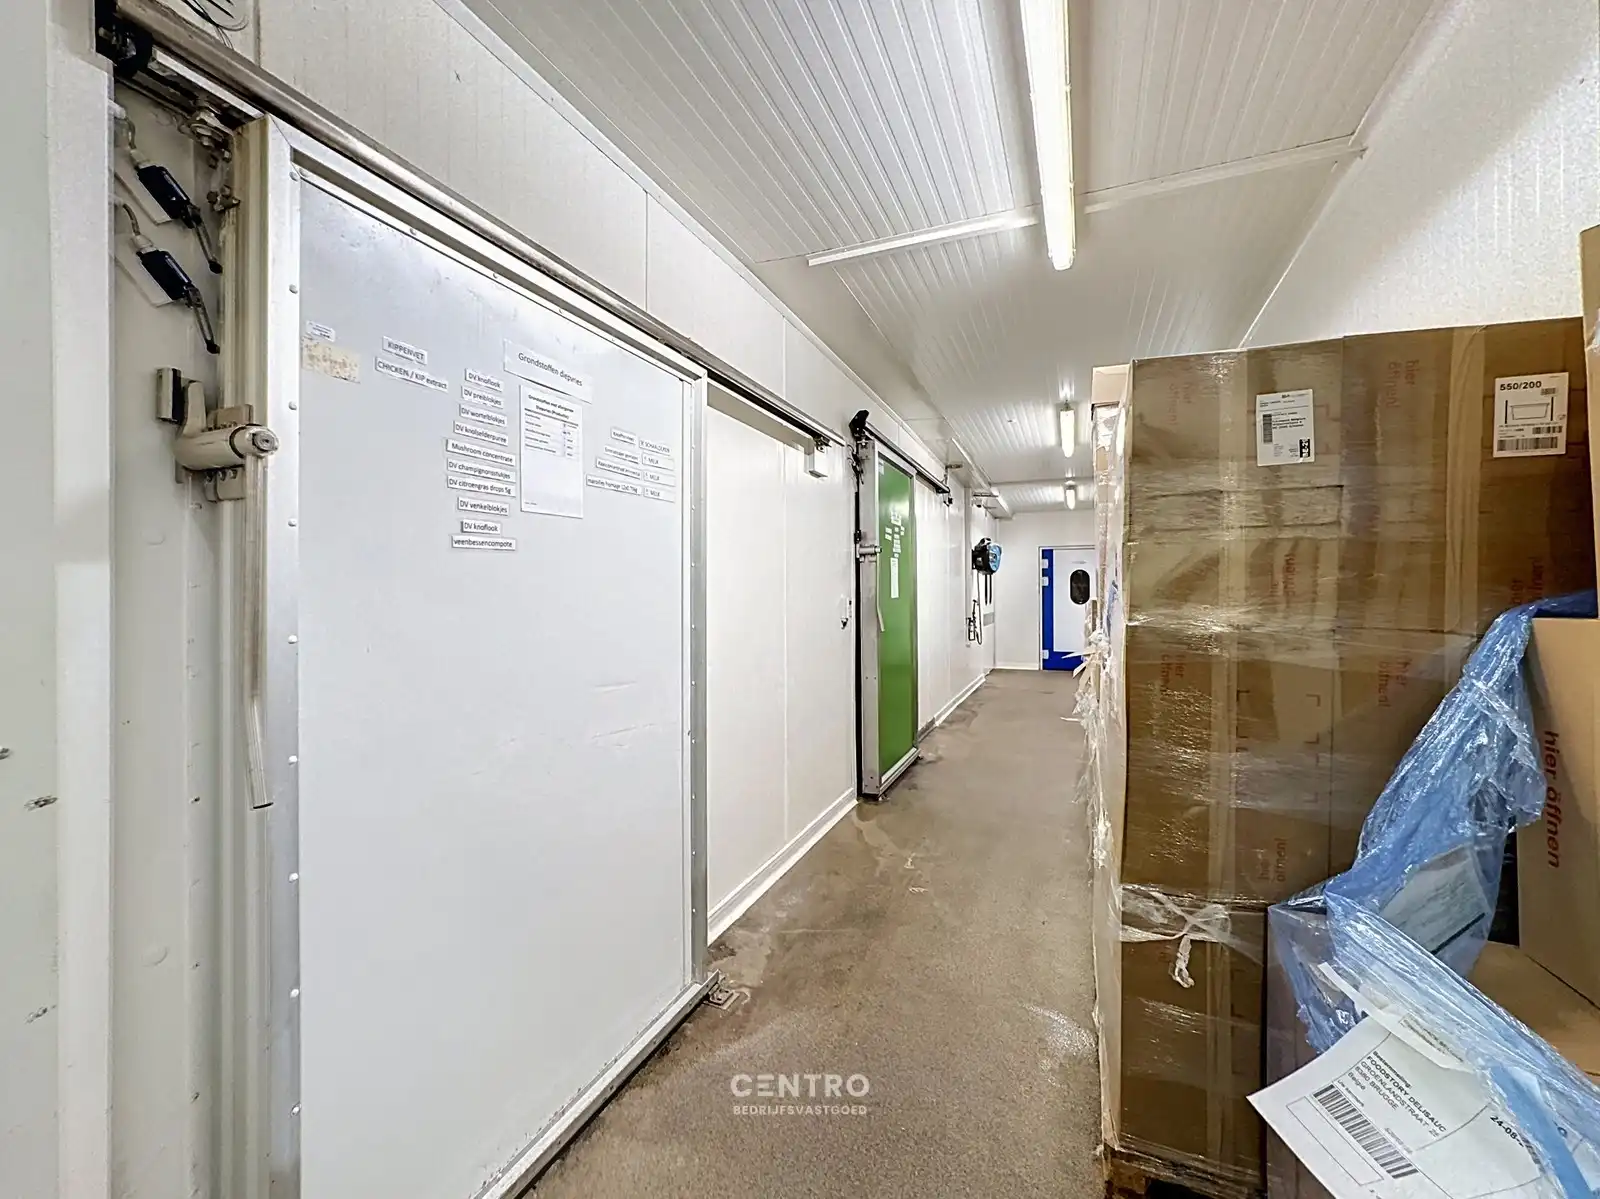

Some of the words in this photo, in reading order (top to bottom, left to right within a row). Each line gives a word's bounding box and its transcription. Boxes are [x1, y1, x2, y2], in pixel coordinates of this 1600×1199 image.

[518, 352, 559, 375] Grondstoffen
[377, 361, 409, 377] CHICKEN
[426, 378, 447, 389] extract
[468, 372, 476, 380] DV
[1499, 381, 1542, 391] 550/200
[464, 389, 472, 397] DV
[461, 407, 469, 415] DV
[456, 424, 464, 432] DV
[451, 443, 481, 455] Mushroom
[482, 451, 513, 463] concentrate
[458, 480, 489, 490] citroengras
[490, 484, 504, 492] drops
[470, 503, 507, 513] venkelblokjes
[464, 522, 473, 530] DV
[473, 523, 498, 532] knoflook
[454, 538, 513, 548] veenbessencompote
[1544, 730, 1560, 780] hier
[1547, 786, 1562, 869] öffnen
[1360, 1061, 1429, 1127] GROENLANDSTRAAT
[1366, 1055, 1409, 1097] FOODSTORY
[1408, 1096, 1447, 1132] DELISAUC
[1369, 1081, 1399, 1110] BRUGGE
